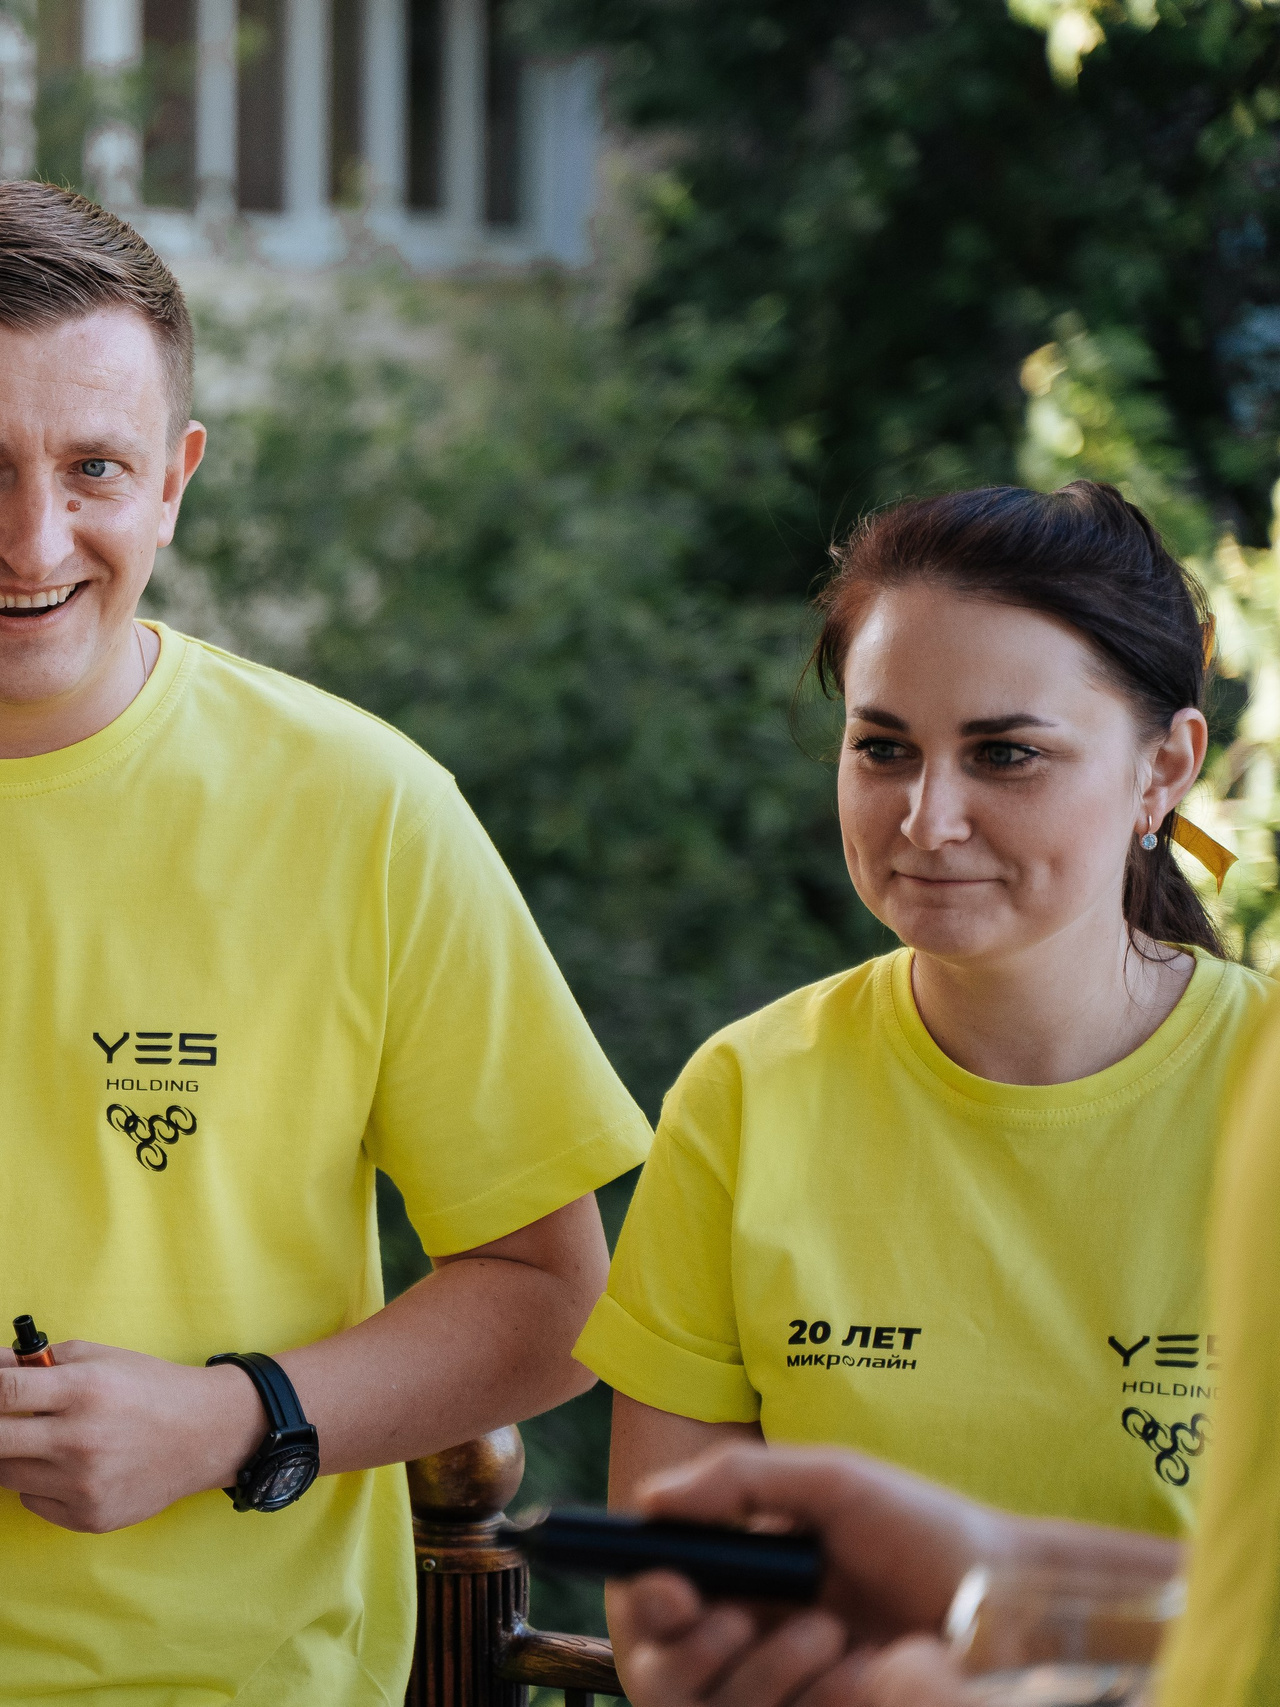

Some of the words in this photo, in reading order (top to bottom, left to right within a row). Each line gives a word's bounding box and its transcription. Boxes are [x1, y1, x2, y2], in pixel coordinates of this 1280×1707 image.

[92, 1032, 218, 1067] YES
[106, 1078, 199, 1093] HOLDING
[787, 1319, 832, 1345] 20
[841, 1325, 922, 1351] ЛЕТ
[786, 1354, 917, 1370] микролайн
